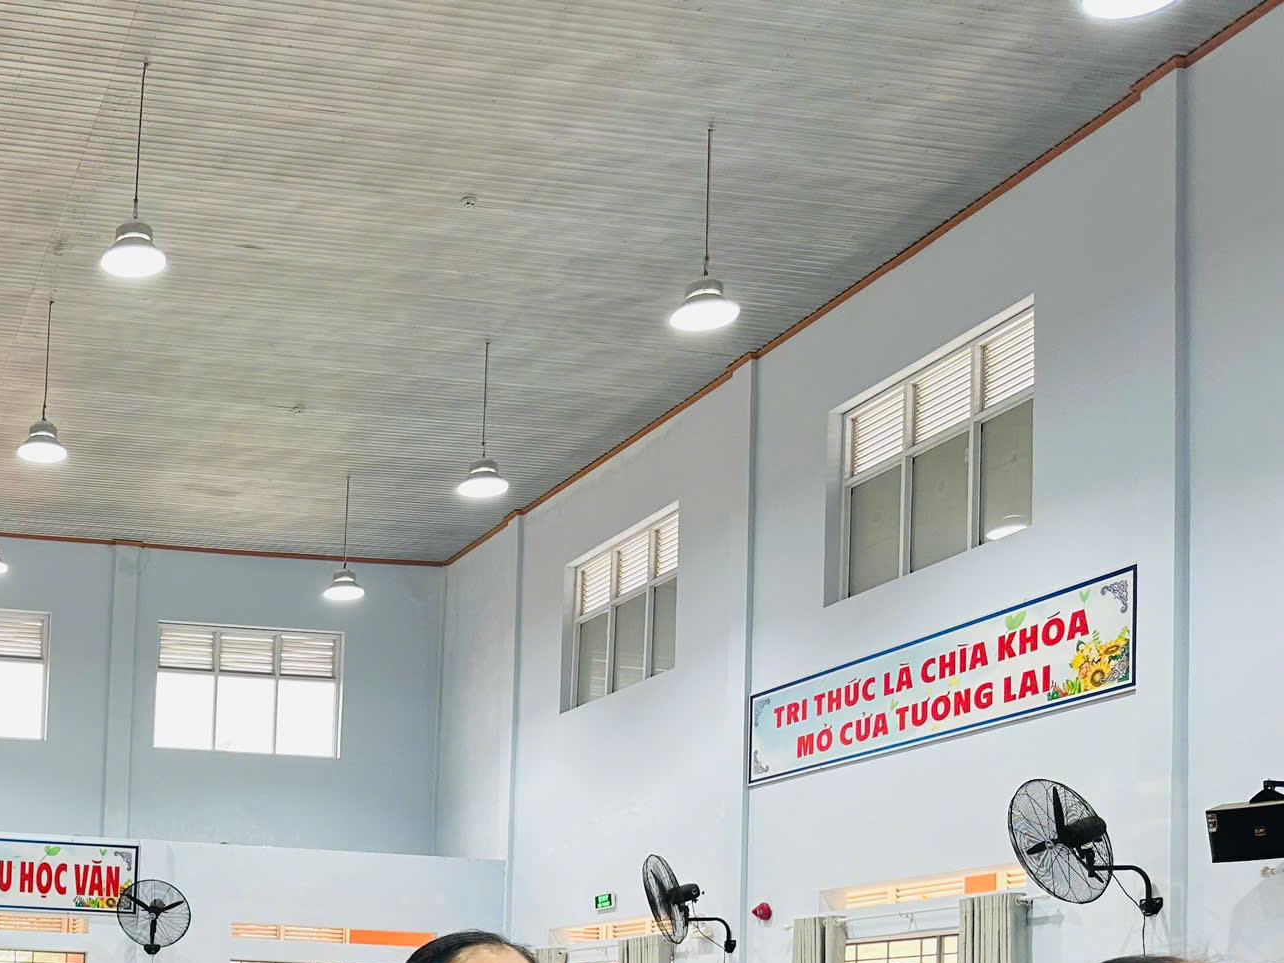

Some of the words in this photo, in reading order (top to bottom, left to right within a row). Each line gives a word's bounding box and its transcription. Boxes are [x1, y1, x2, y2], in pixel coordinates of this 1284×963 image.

[773, 698, 808, 729] TRI
[813, 677, 876, 717] THỨC
[883, 662, 914, 697] LÀ
[920, 642, 989, 684] CHÌA
[997, 609, 1090, 662] KHÓA
[796, 723, 833, 759] MỞ
[839, 711, 889, 746] CỬA
[895, 682, 994, 732] TƯƠNG
[1003, 664, 1051, 704] LAI
[19, 861, 69, 899] HỌC
[74, 859, 121, 898] VĂN
